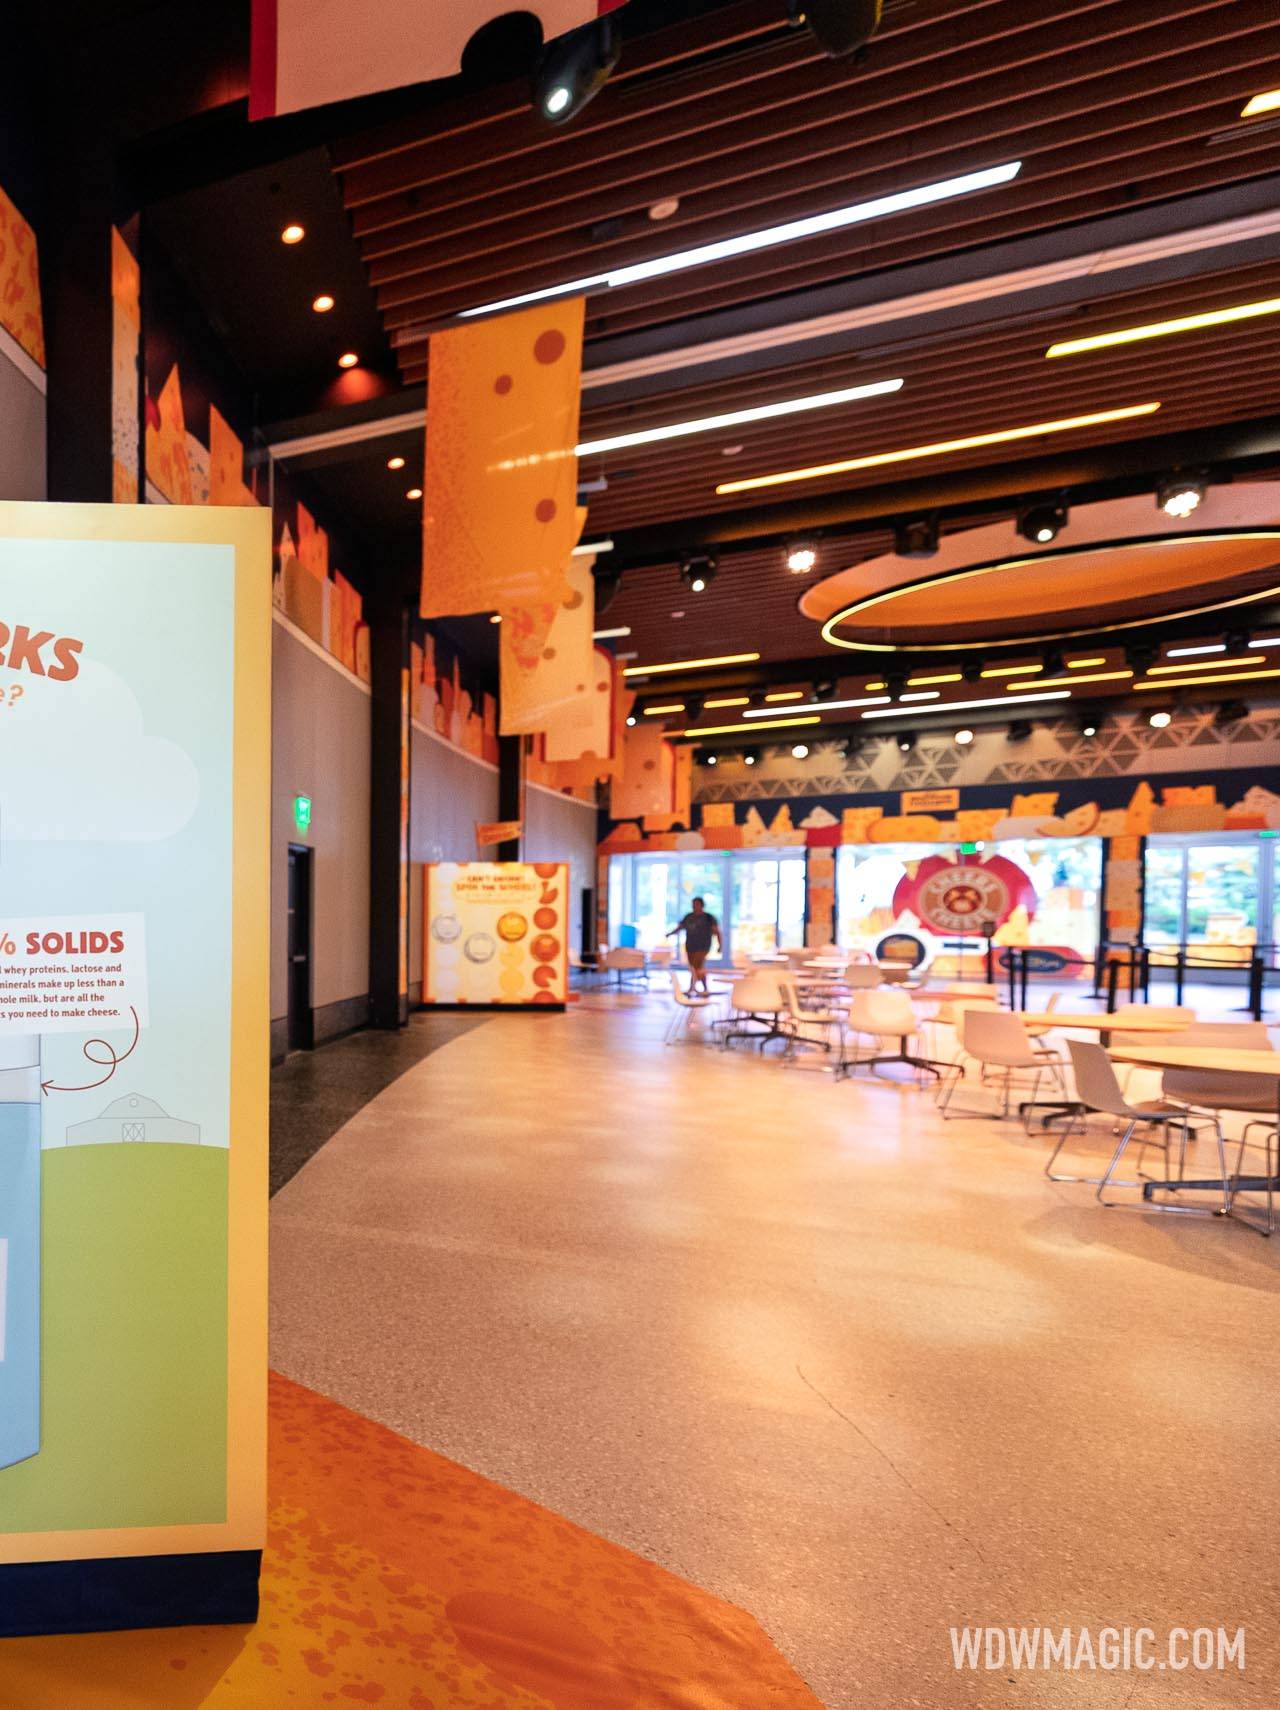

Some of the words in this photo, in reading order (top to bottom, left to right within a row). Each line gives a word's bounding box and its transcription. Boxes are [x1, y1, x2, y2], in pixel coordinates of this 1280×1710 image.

[26, 931, 124, 955] SOLIDS
[3, 965, 28, 977] whey
[70, 964, 104, 974] lactose
[104, 963, 122, 973] and
[37, 979, 62, 989] make
[63, 980, 76, 991] up
[76, 978, 95, 988] less
[96, 977, 118, 987] than
[118, 979, 125, 987] a
[43, 993, 59, 1003] but
[60, 995, 75, 1003] are
[76, 992, 89, 1002] all
[90, 992, 105, 1002] the
[7, 1011, 25, 1021] you
[25, 1008, 49, 1018] need
[50, 1008, 60, 1018] to
[61, 1007, 86, 1017] make
[87, 1007, 121, 1017] cheese.
